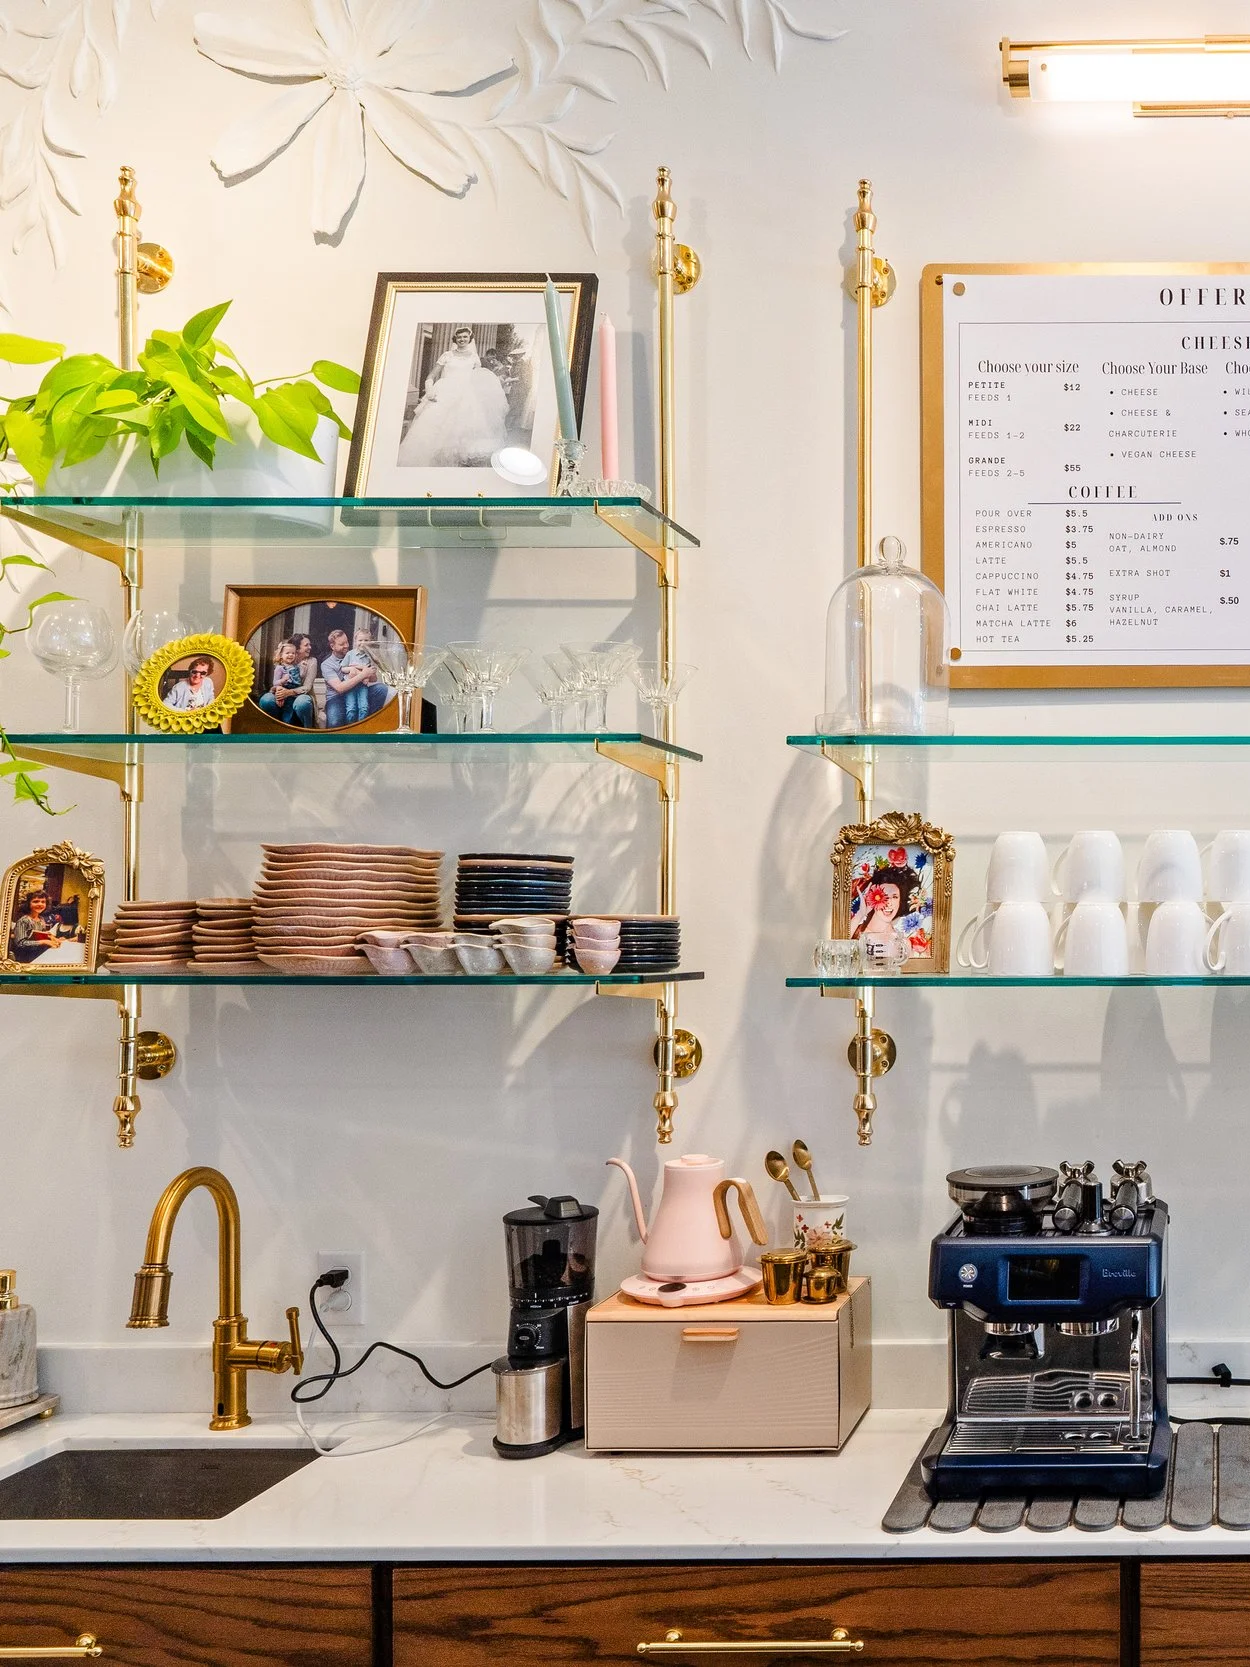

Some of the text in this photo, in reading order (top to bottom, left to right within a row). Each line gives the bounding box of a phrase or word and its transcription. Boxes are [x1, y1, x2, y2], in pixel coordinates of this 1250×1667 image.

[978, 360, 1078, 375] Choose your size
[1102, 362, 1207, 374] Choose Your Base
[1064, 383, 1080, 391] $12
[1064, 464, 1080, 472] $55
[1069, 486, 1136, 498] COFFEE
[1066, 525, 1093, 533] $3.75
[1066, 541, 1076, 549] $5
[1109, 545, 1131, 553] OAT,
[1066, 572, 1093, 580] $4.75
[1066, 588, 1093, 596] $4.75
[1066, 604, 1094, 612] $5.75
[1066, 619, 1076, 627] $6
[1066, 635, 1093, 643] $5.25
